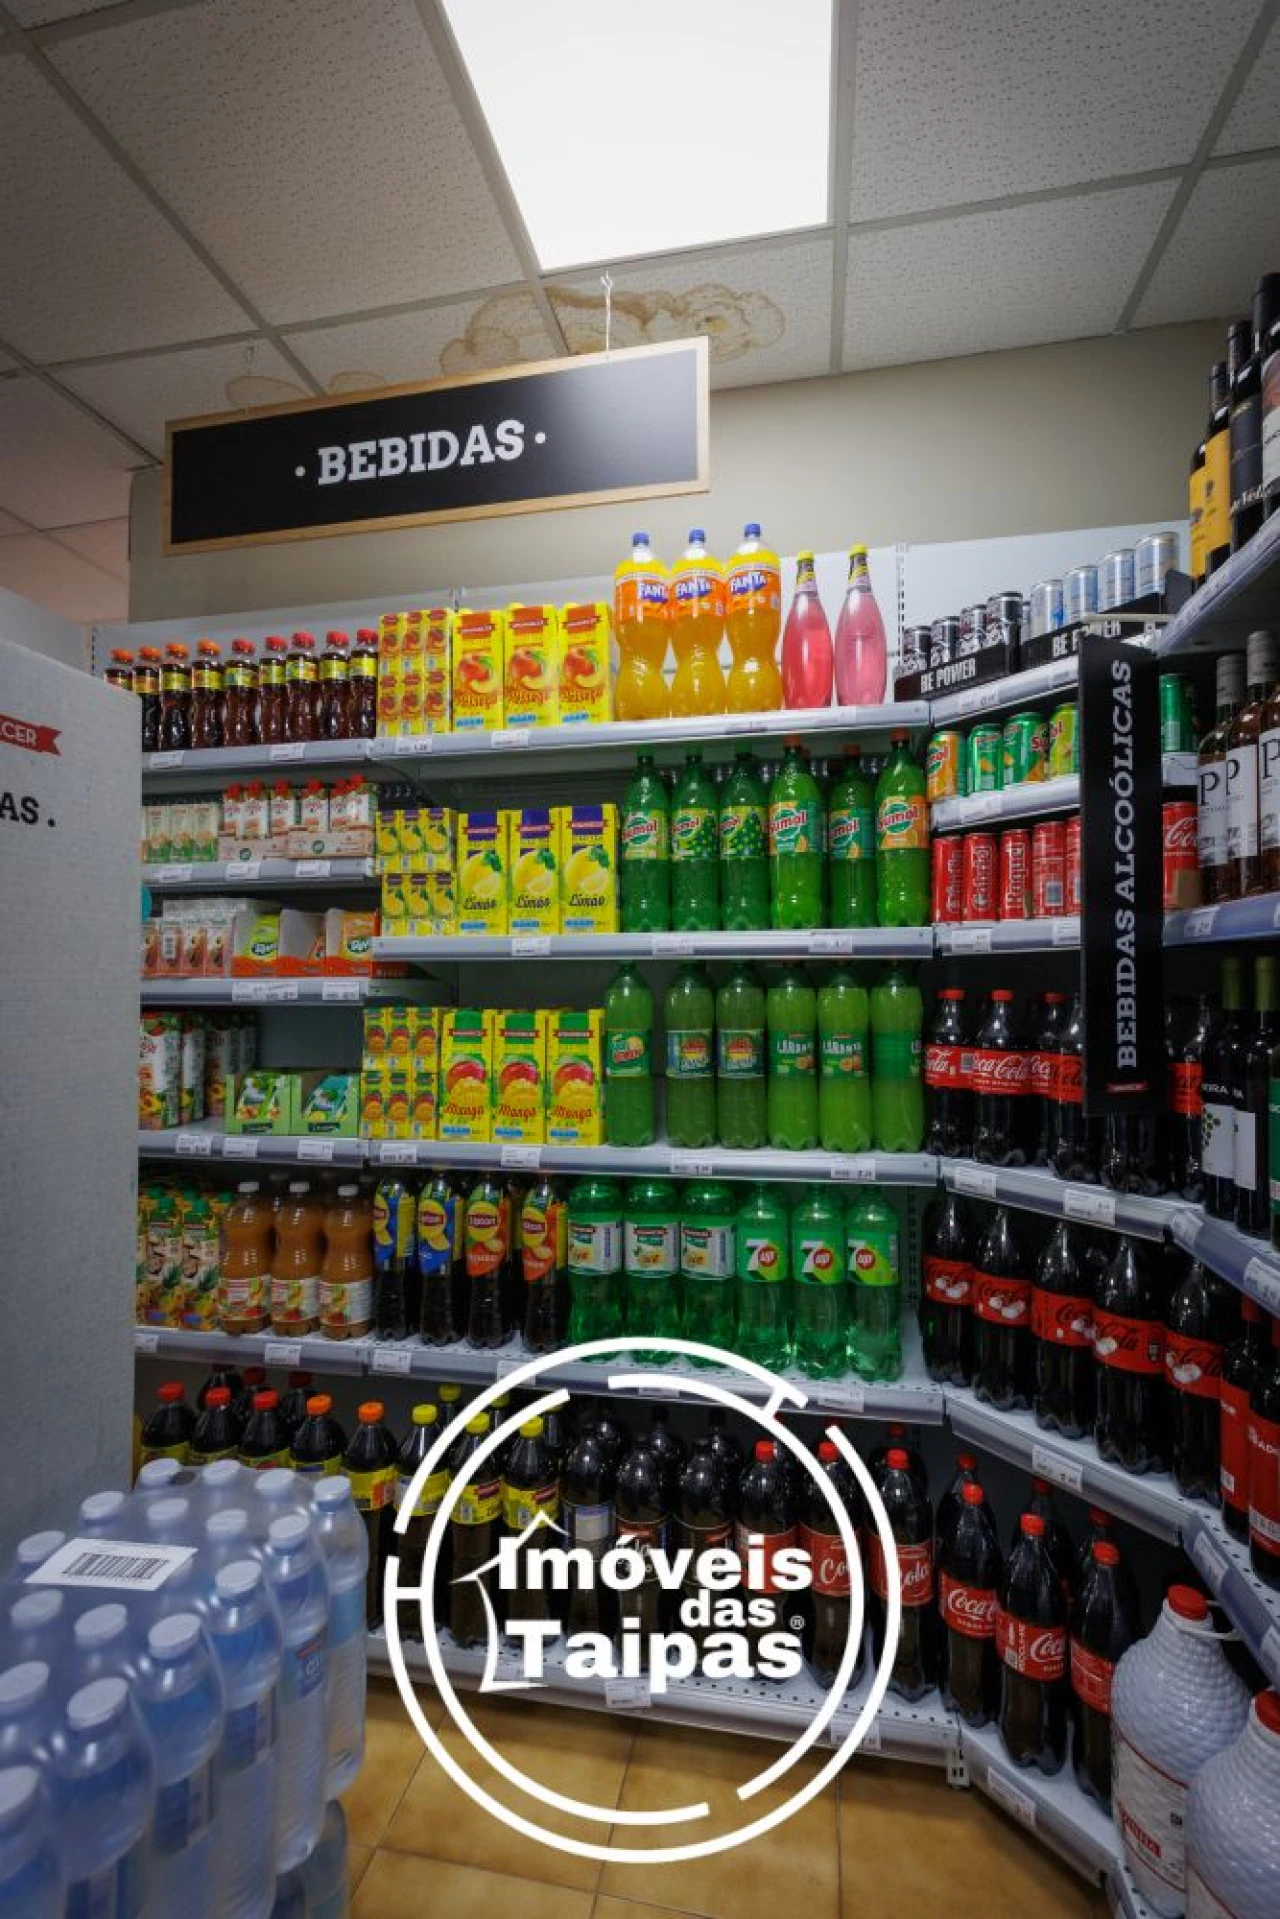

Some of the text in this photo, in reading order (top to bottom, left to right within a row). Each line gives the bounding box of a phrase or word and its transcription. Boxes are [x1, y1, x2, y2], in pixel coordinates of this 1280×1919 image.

[317, 419, 525, 486] BEBIDAS
[1108, 659, 1136, 902] ALCOÓLICAS
[1115, 908, 1137, 1069] BEBIDAS
